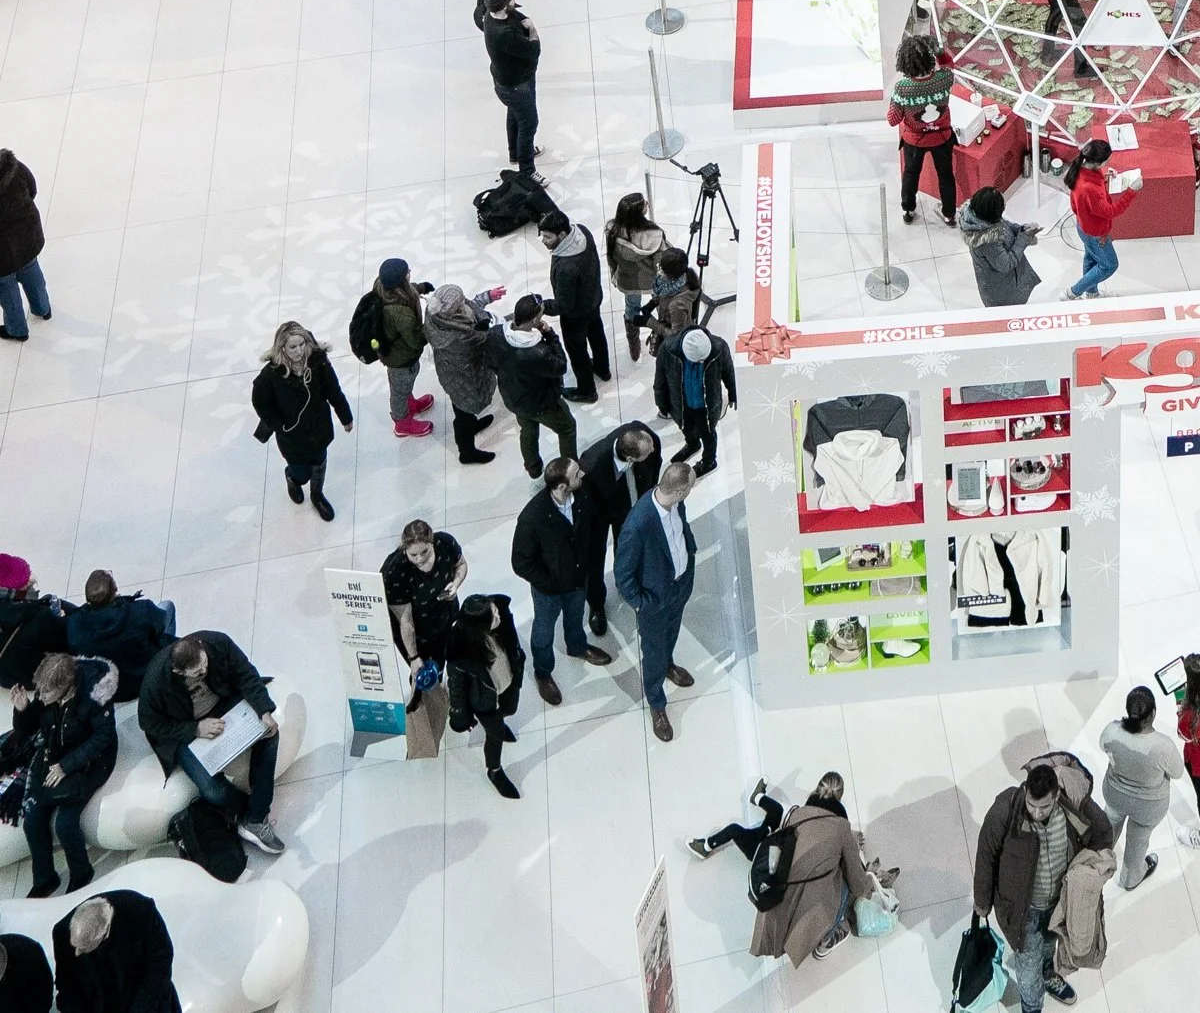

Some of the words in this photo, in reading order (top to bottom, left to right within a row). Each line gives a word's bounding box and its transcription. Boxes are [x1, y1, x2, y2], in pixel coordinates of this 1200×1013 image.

[755, 176, 773, 288] #GIVEJOYSHOP
[862, 325, 946, 344] #KOHLS
[1006, 313, 1092, 332] @KOHLS
[961, 418, 1001, 428] ACTIVE
[331, 592, 384, 604] SONGWRITER
[344, 600, 373, 610] SERIES
[886, 610, 925, 619] LOVELY
